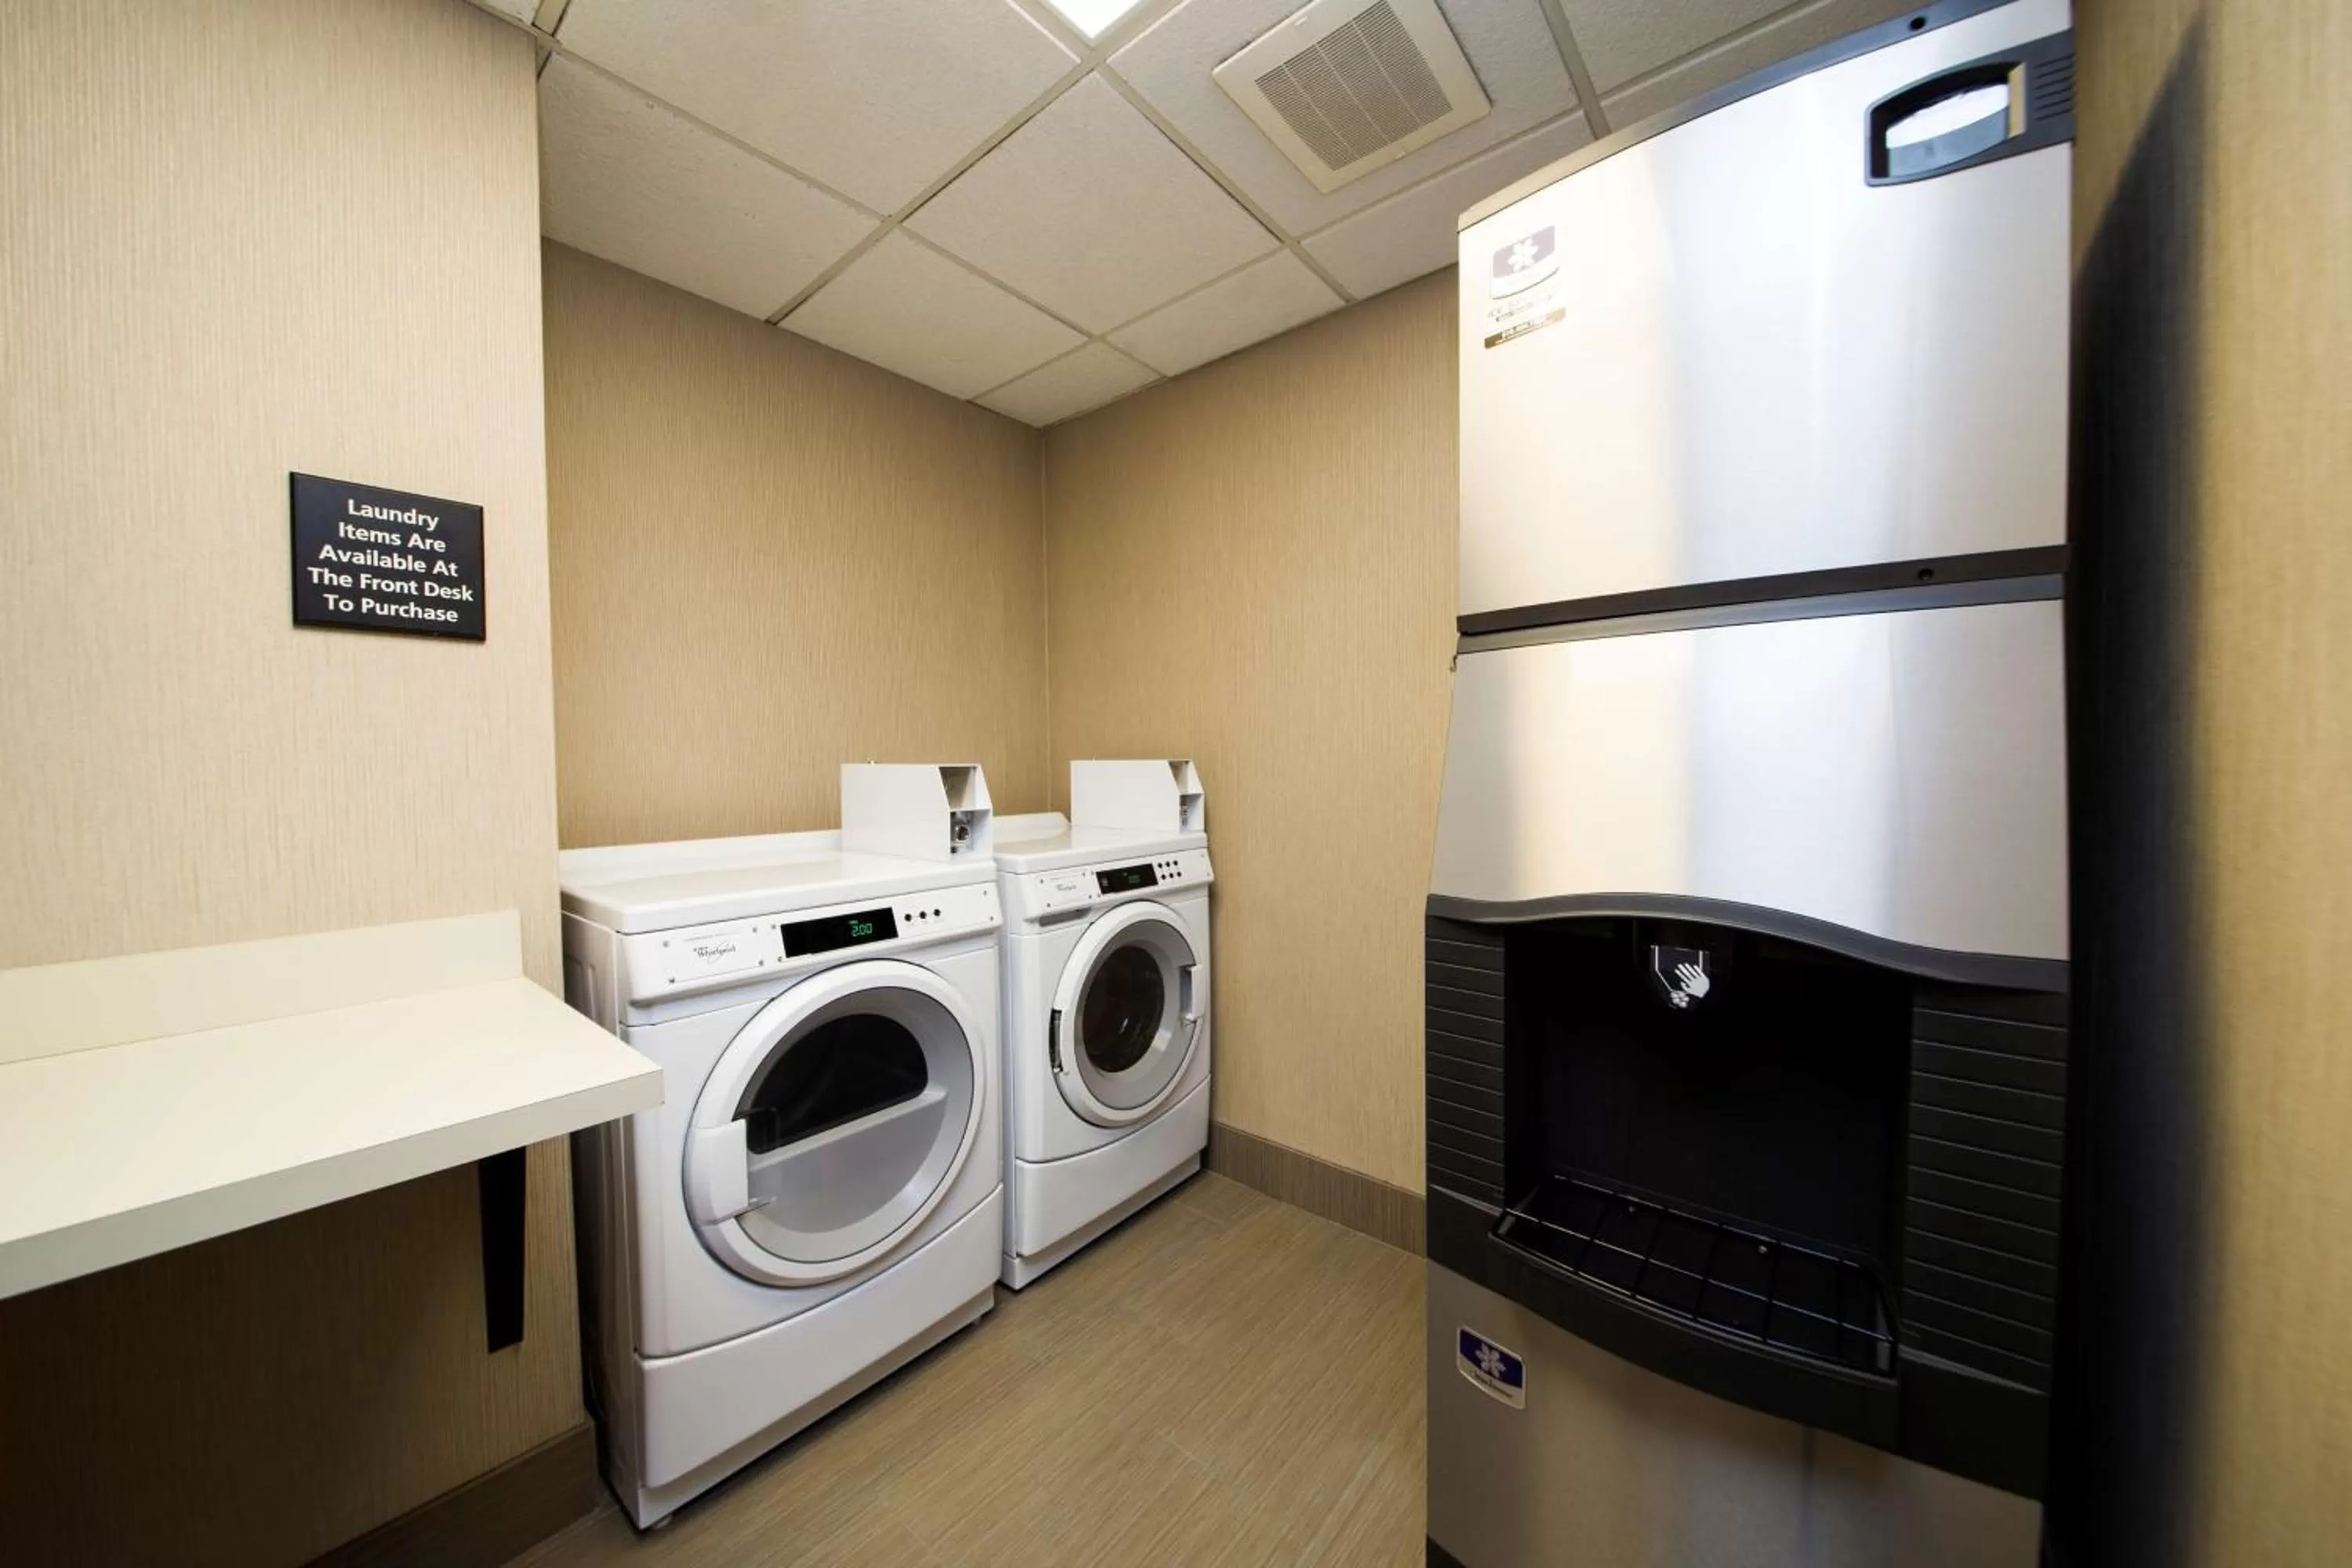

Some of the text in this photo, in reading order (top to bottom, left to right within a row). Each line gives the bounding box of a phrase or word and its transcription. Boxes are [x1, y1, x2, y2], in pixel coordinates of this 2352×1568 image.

[347, 499, 439, 531] Laundry
[338, 521, 446, 553] Items Are
[318, 544, 458, 577] Available At
[307, 567, 474, 601] The Front Desk
[323, 593, 459, 622] To Purchase
